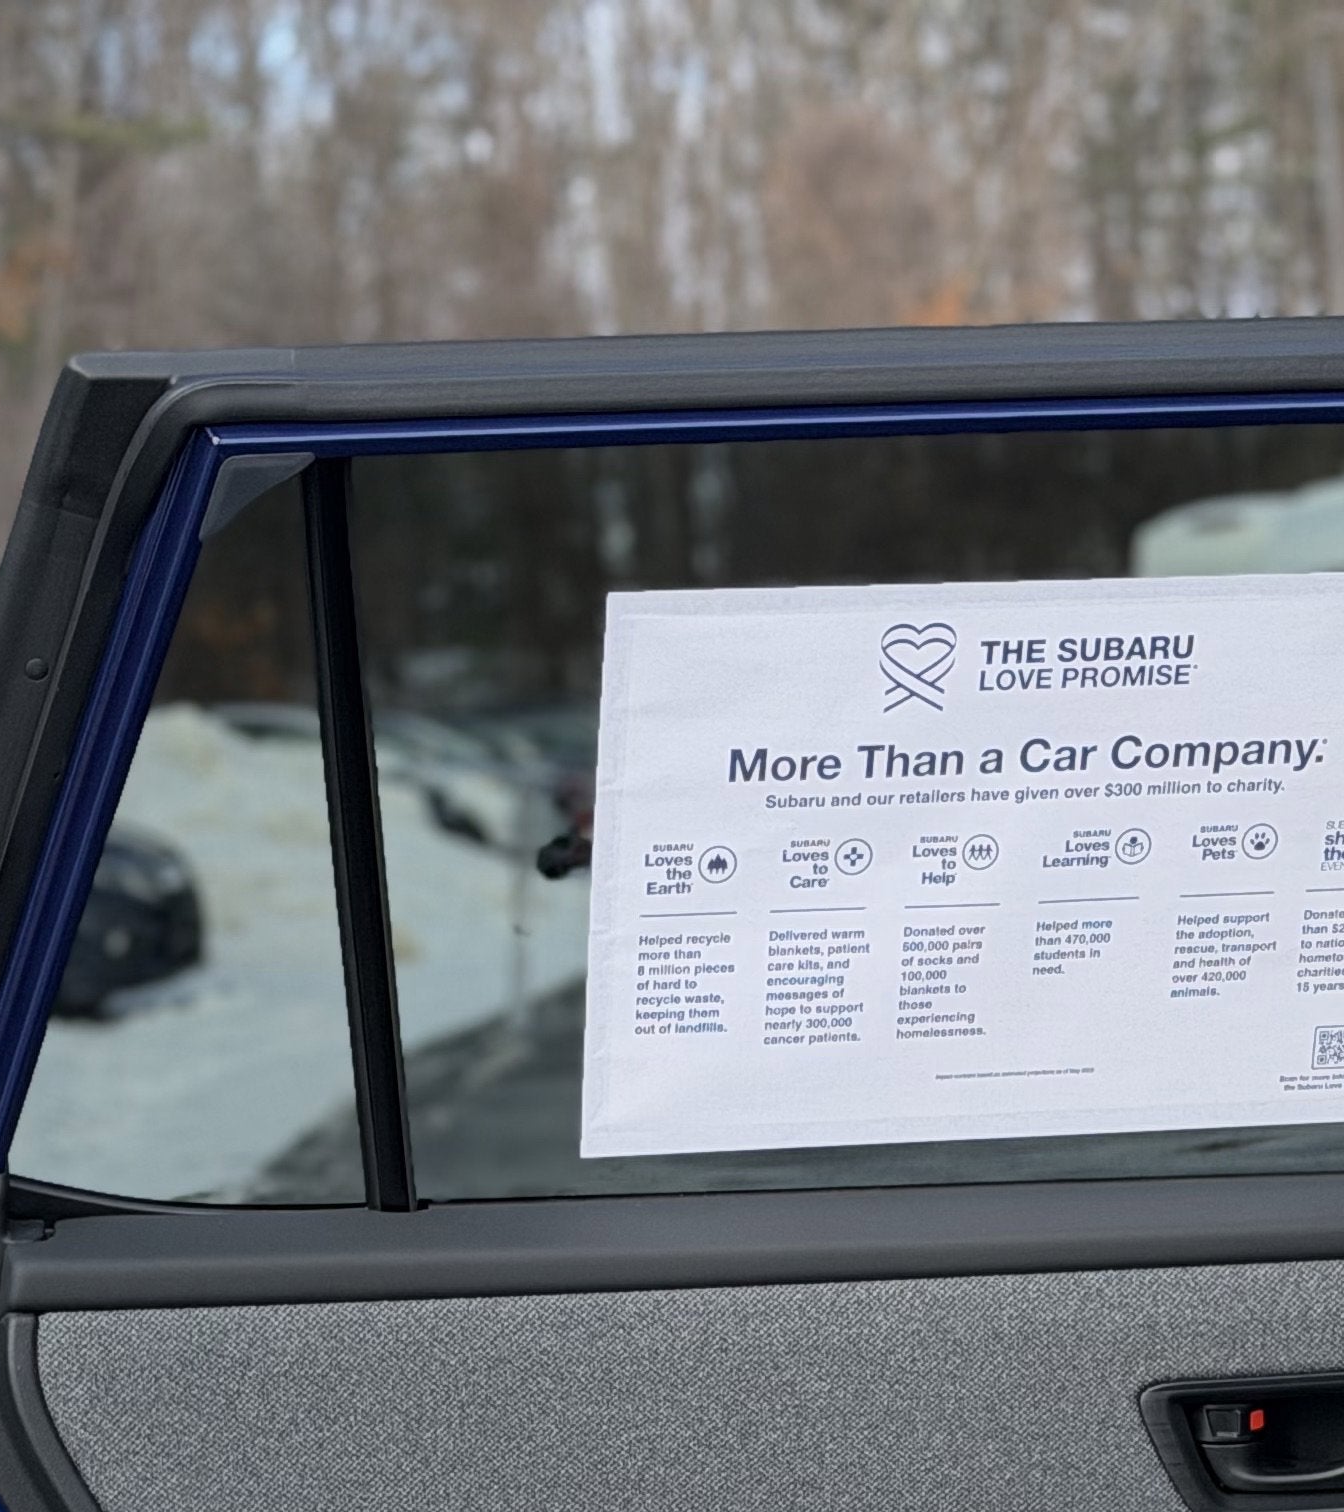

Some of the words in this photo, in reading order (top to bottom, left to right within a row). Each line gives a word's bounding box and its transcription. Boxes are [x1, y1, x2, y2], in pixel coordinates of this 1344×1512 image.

[981, 639, 1046, 664] THE
[1057, 635, 1194, 662] SUBARU
[979, 668, 1053, 691] LOVE
[1061, 664, 1192, 688] PROMISE
[729, 748, 841, 782] More
[857, 744, 963, 778] Than
[979, 749, 1003, 774] a
[1020, 738, 1097, 772] Car
[765, 794, 825, 808] Subaru
[830, 792, 861, 807] and
[867, 794, 895, 805] our
[899, 789, 965, 804] retailers
[971, 788, 1009, 801] have
[1015, 786, 1058, 803] given
[1064, 787, 1100, 798] over
[1104, 782, 1142, 797] $300
[1147, 781, 1201, 795] million
[1207, 780, 1222, 793] to
[1227, 778, 1284, 794] charity.
[1073, 829, 1111, 838] SUBARU
[1200, 825, 1238, 833] SUBARU
[790, 839, 830, 847] SUBARU
[1065, 840, 1110, 852] Loves
[1192, 835, 1236, 847] Loves
[653, 843, 693, 852] SUBARU
[912, 845, 956, 857] Loves
[782, 850, 829, 862] Loves
[1202, 848, 1235, 860] Pets
[645, 854, 692, 867] Loves
[941, 858, 956, 869] to
[1042, 854, 1109, 868] Learning
[666, 868, 692, 880] the
[812, 863, 828, 874] to
[789, 876, 828, 888] Care
[921, 872, 956, 886] Help
[646, 881, 691, 895] Earth
[1177, 914, 1219, 926] Helped
[1223, 912, 1269, 925] support
[903, 925, 955, 937] Donated
[958, 926, 985, 935] over
[1036, 920, 1078, 932] Helped
[1082, 920, 1112, 929] more
[1302, 924, 1328, 934] than
[639, 934, 682, 947] Helped
[686, 933, 730, 946] recycle
[769, 929, 827, 941] Delivered
[831, 930, 864, 939] warm
[1035, 936, 1061, 946] than
[1065, 933, 1110, 945] 470,000
[1176, 930, 1194, 939] the
[1198, 928, 1254, 940] adoption,
[768, 945, 824, 956] blankets,
[827, 943, 869, 956] patient
[902, 940, 949, 952] 500,000
[952, 940, 982, 952] pairs
[1174, 945, 1217, 954] rescue,
[1222, 941, 1276, 953] transport
[1301, 940, 1312, 949] to
[638, 951, 670, 960] more
[674, 949, 701, 959] than
[901, 956, 914, 966] of
[917, 955, 952, 966] socks
[956, 953, 979, 964] and
[1033, 949, 1085, 960] students
[1089, 948, 1100, 957] in
[767, 962, 794, 971] care
[798, 960, 823, 971] kits,
[826, 958, 849, 969] and
[1173, 958, 1195, 969] and
[1199, 957, 1235, 967] health
[1239, 955, 1251, 966] of
[648, 964, 690, 975] million
[694, 963, 734, 976] pieces
[901, 970, 947, 981] 100,000
[1032, 964, 1064, 975] need.
[766, 974, 844, 986] encouraging
[1172, 974, 1198, 983] over
[1201, 970, 1246, 982] 420,000
[636, 980, 649, 990] of
[653, 979, 681, 989] hard
[684, 979, 697, 989] to
[899, 984, 950, 996] blankets
[954, 984, 966, 993] to
[1297, 982, 1309, 992] 15
[766, 990, 828, 1001] messages
[832, 988, 844, 998] of
[1170, 986, 1220, 997] animals.
[636, 994, 681, 1007] recycle
[685, 993, 724, 1004] waste,
[898, 1000, 932, 1010] those
[635, 1009, 685, 1021] keeping
[689, 1008, 719, 1018] them
[765, 1005, 796, 1016] hope
[800, 1004, 811, 1014] to
[816, 1002, 863, 1015] support
[764, 1019, 802, 1031] nearly
[806, 1017, 852, 1028] 300,000
[897, 1012, 975, 1026] experiencing
[634, 1024, 655, 1034] out
[658, 1023, 671, 1034] of
[675, 1022, 727, 1033] landfills.
[896, 1027, 985, 1039] homelessness.
[763, 1035, 805, 1044] cancer
[808, 1032, 860, 1045] patients.
